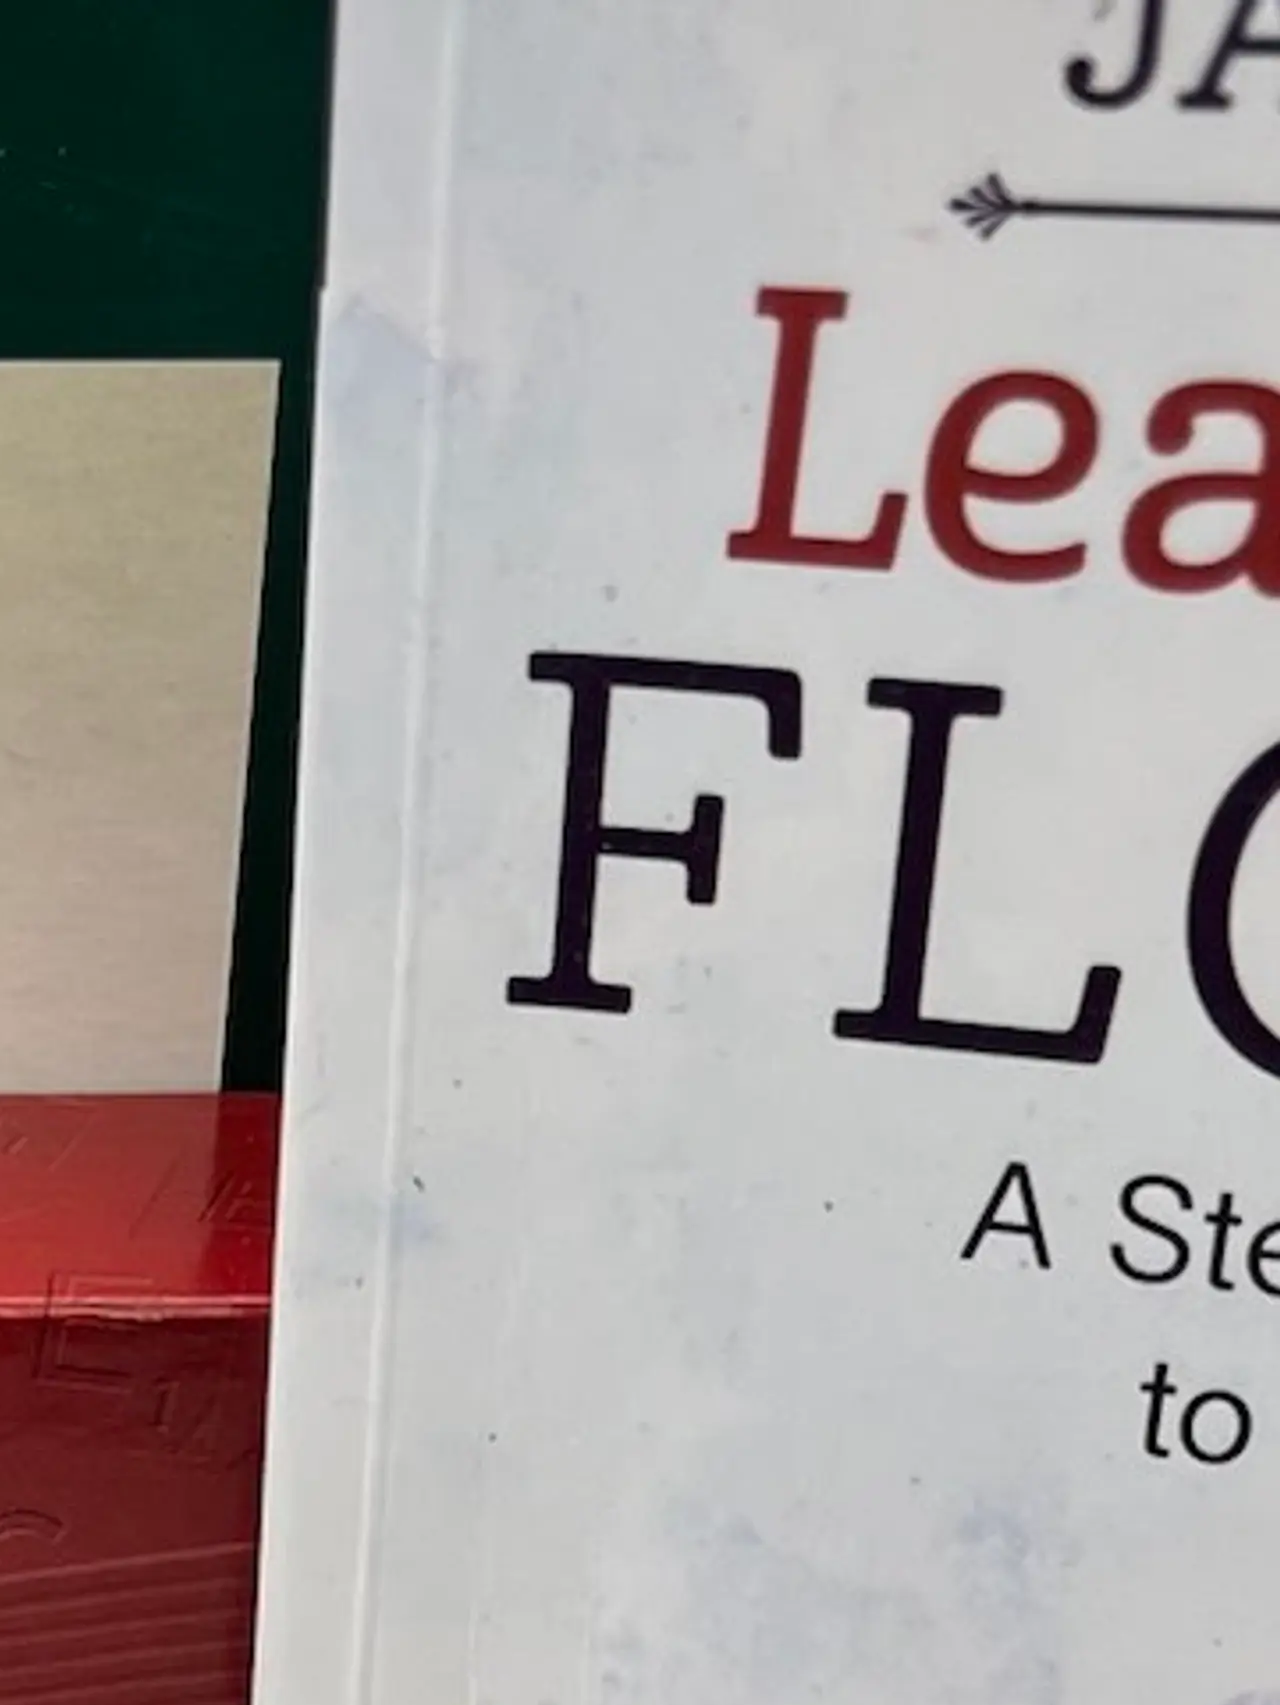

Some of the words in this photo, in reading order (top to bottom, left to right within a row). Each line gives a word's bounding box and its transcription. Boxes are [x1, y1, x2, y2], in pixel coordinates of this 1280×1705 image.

[725, 285, 1280, 598] Lea
[960, 1161, 1051, 1270] A
[1140, 1363, 1252, 1465] to
